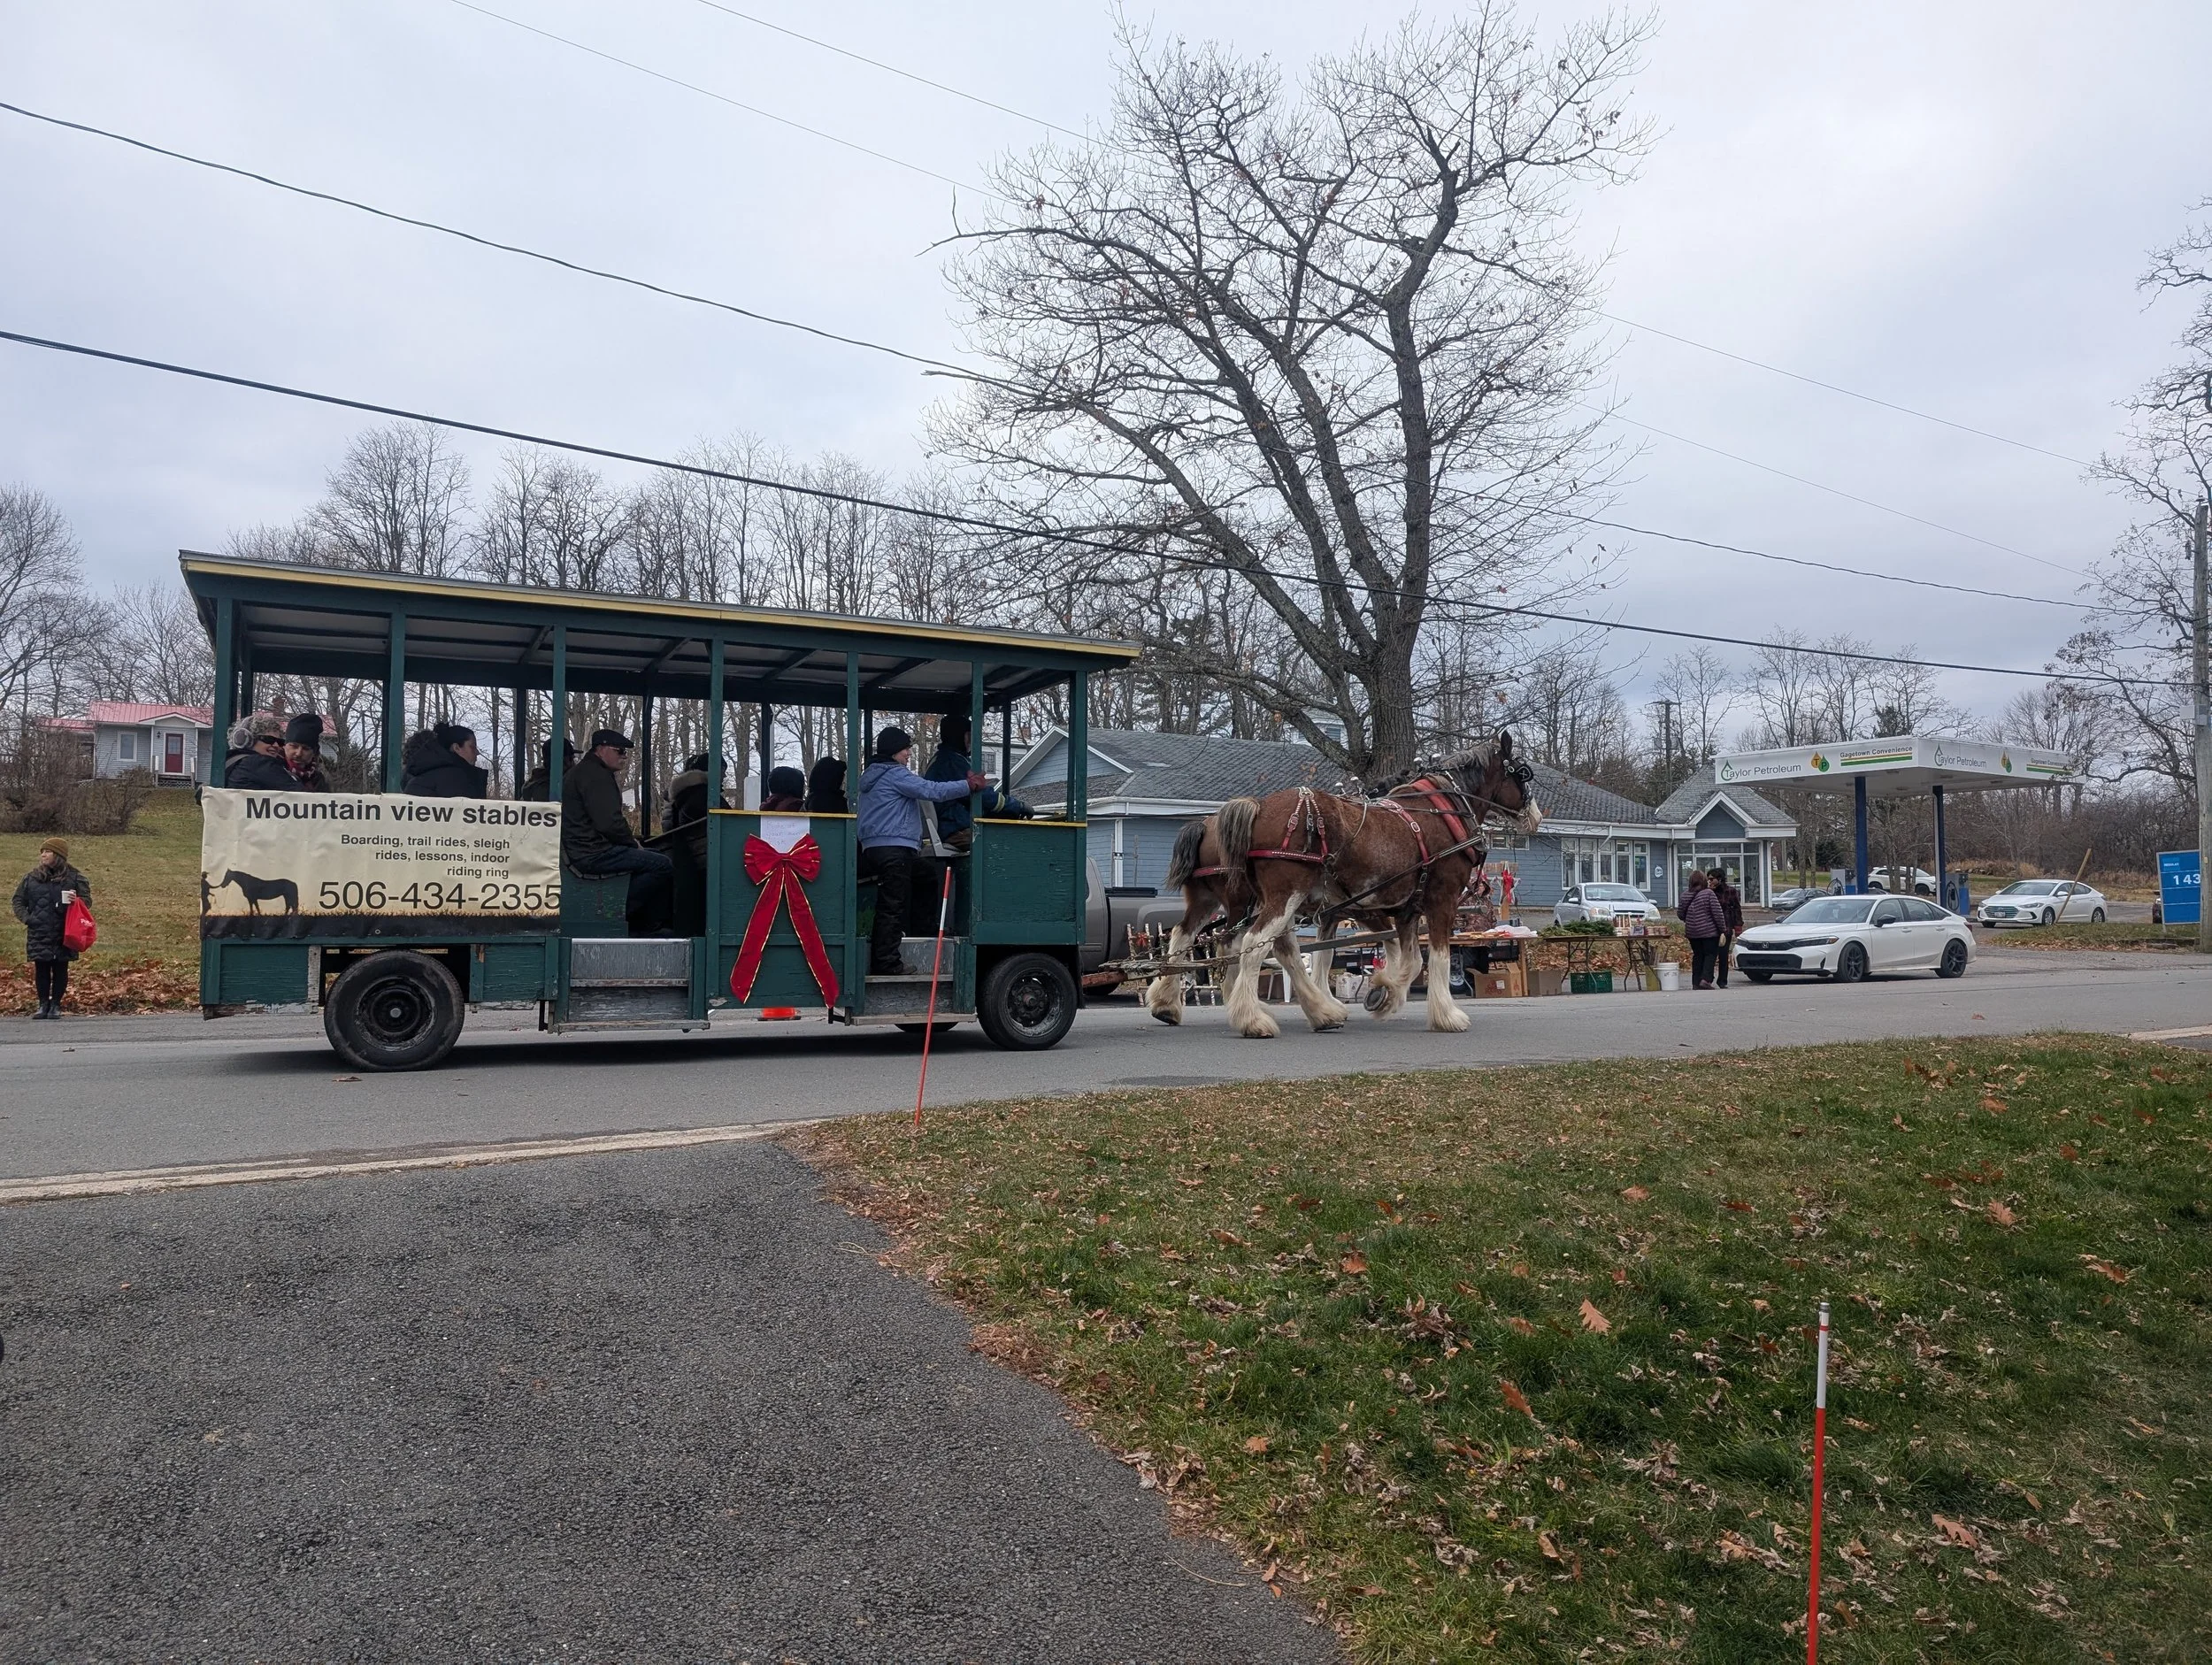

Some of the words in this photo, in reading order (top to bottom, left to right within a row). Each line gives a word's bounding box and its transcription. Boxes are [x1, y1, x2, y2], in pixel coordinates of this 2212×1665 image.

[1871, 746, 1913, 755] Convenience
[1938, 754, 1955, 766] Taylor
[1956, 756, 1987, 768] Petroleum
[1724, 768, 1752, 779] Taylor
[1754, 764, 1801, 775] Petroleum
[246, 797, 381, 821] Mountain
[390, 801, 454, 823] view
[462, 804, 557, 828] stables
[341, 834, 403, 848] Boarding,
[407, 836, 432, 847] trail
[435, 837, 470, 848] rides,
[473, 839, 511, 851] sleigh
[375, 850, 411, 862] rides,
[415, 851, 467, 863] lessons,
[471, 852, 511, 863] indoor
[447, 867, 482, 879] riding
[486, 867, 510, 879] ring
[319, 880, 561, 910] 506-434-2355
